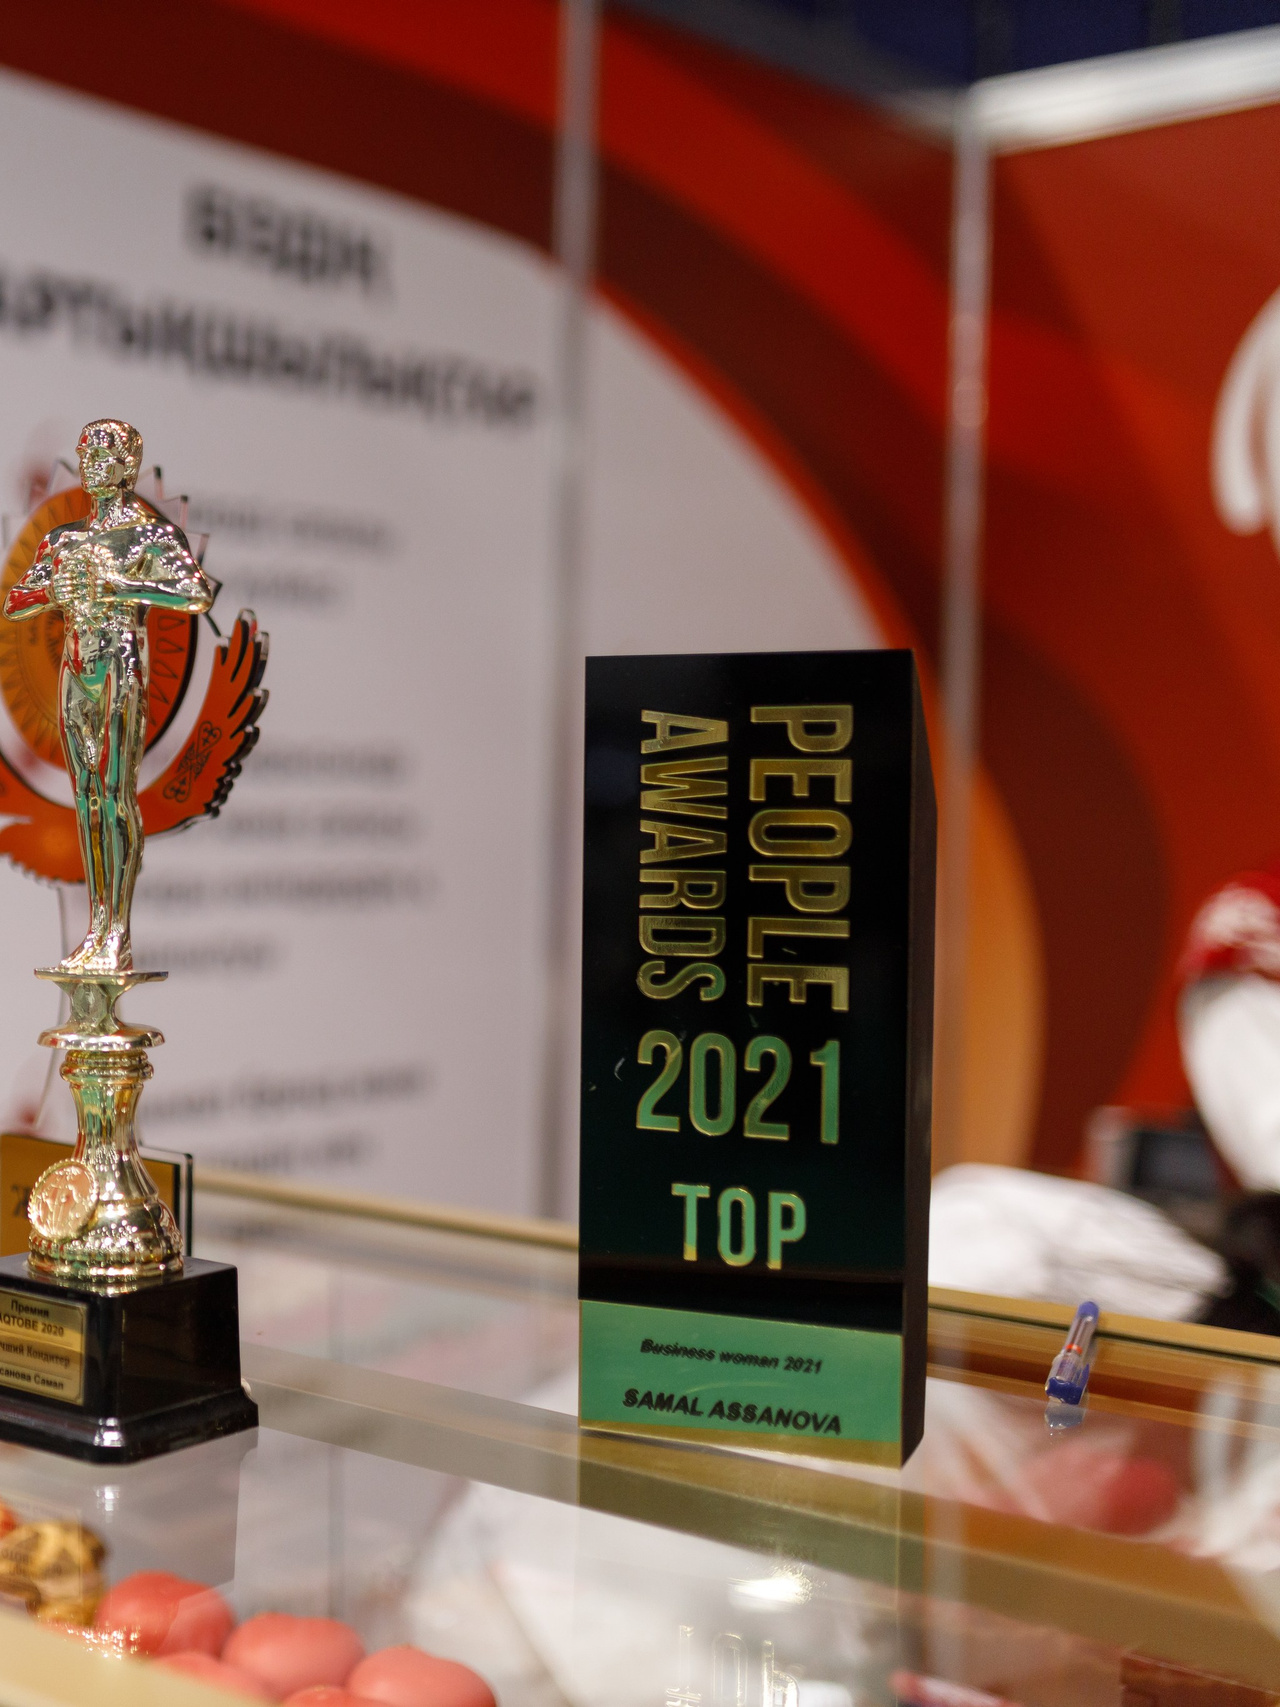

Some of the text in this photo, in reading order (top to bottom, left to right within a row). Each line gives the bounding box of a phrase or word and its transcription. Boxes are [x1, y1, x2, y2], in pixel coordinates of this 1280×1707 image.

[637, 709, 729, 1003] AWARDS
[747, 704, 853, 1012] PEOPLE
[636, 1029, 840, 1145] 2021
[671, 1183, 806, 1270] TOP
[10, 1300, 50, 1318] Премия
[41, 1322, 64, 1337] 2020
[27, 1344, 71, 1368] Кондитер
[640, 1338, 717, 1361] Business
[783, 1355, 823, 1374] 2021
[34, 1374, 64, 1390] Самал
[622, 1388, 842, 1436] SAMAL ASSANOVA
